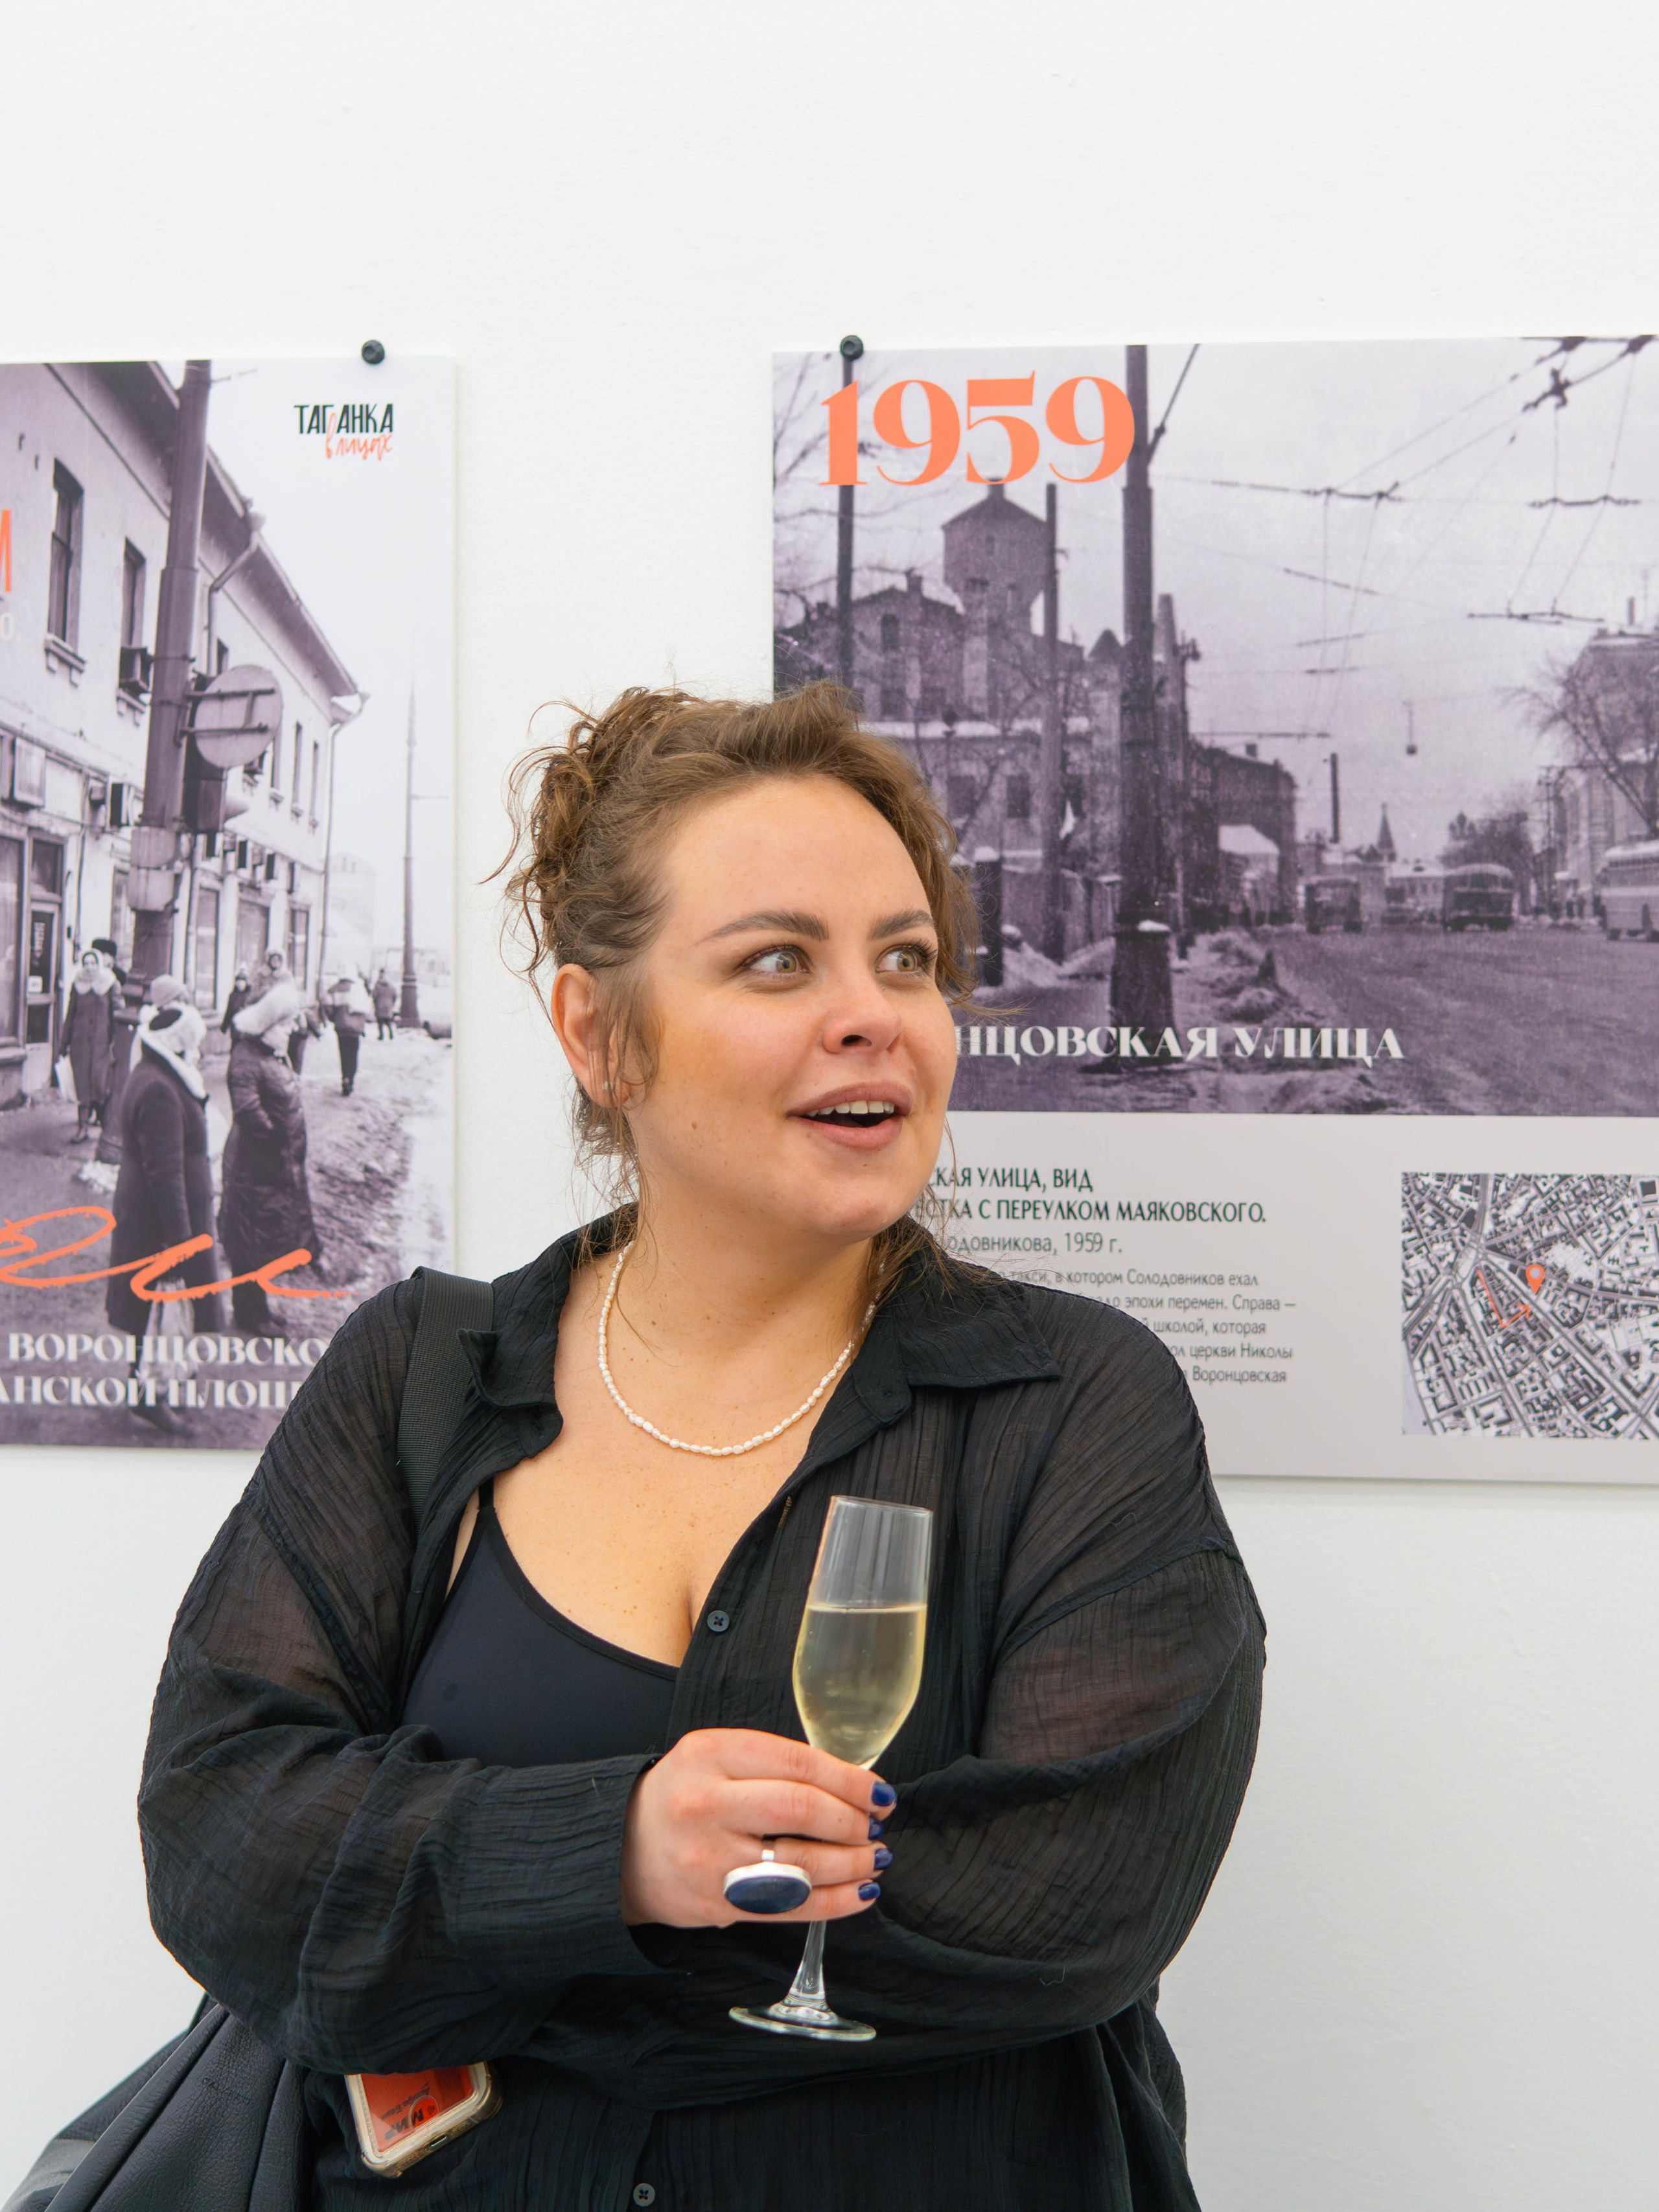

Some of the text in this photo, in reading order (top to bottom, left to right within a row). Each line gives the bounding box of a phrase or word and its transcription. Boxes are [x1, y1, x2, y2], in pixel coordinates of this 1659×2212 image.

[294, 404, 393, 434] ТАГАНКА
[819, 370, 1135, 485] 1959
[1233, 1027, 1405, 1069] УЛИЦА
[978, 1167, 1046, 1192] УЛИЦА,
[1053, 1169, 1093, 1192] ВИД
[979, 1200, 991, 1218] С
[997, 1199, 1109, 1220] ПЕРЕУЛКОМ
[1116, 1201, 1266, 1222] МАЯКОВСКОГО.
[1065, 1232, 1102, 1252] 1959
[1109, 1239, 1122, 1253] г.
[1069, 1271, 1122, 1287] котором
[1126, 1268, 1224, 1286] Солодовников
[1229, 1273, 1259, 1286] ехал
[1124, 1296, 1163, 1309] эпохи
[1168, 1297, 1228, 1312] перемен.
[1233, 1294, 1280, 1314] Справа
[1154, 1318, 1208, 1335] школой,
[1212, 1322, 1267, 1338] которая
[8, 1333, 329, 1371] ВОРОНЦОВСКО
[1190, 1346, 1235, 1362] церкви
[1240, 1342, 1293, 1358] Николы
[1192, 1366, 1287, 1384] Воронцовская
